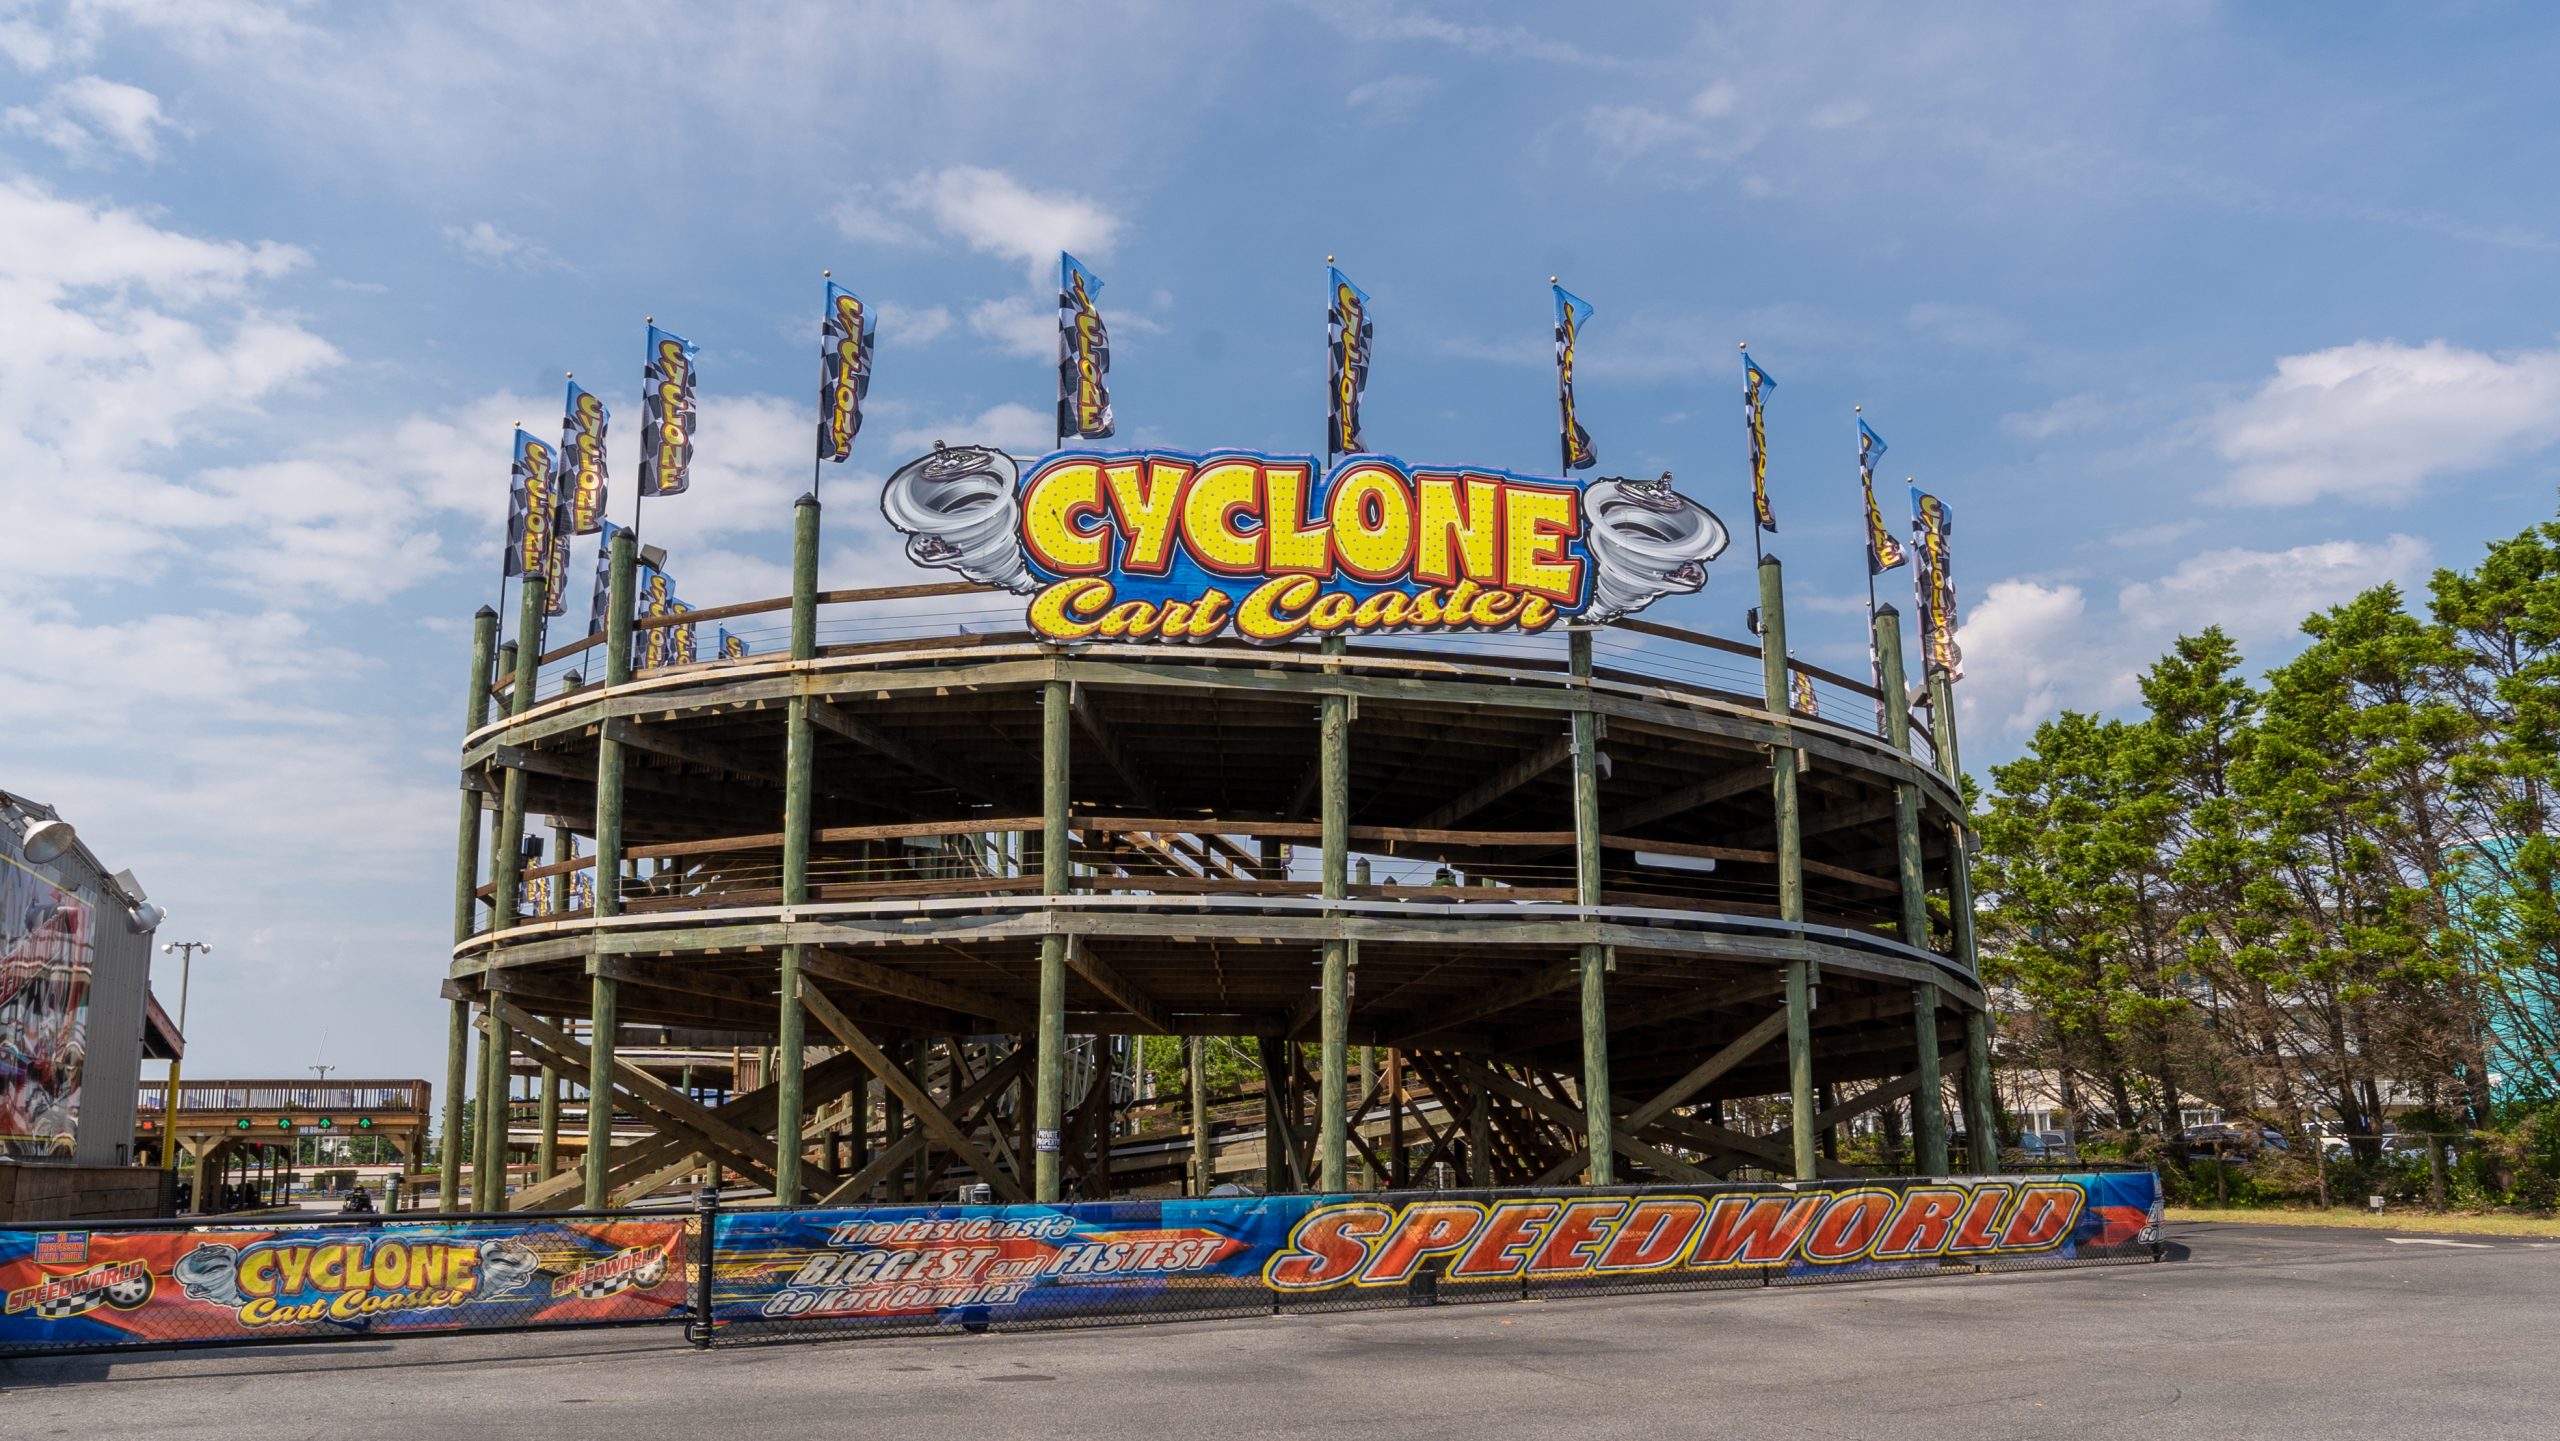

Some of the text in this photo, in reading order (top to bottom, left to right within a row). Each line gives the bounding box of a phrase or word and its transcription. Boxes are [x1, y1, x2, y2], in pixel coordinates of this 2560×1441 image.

[833, 295, 864, 456] CYCLONE
[657, 339, 689, 492] CYCLONE
[574, 392, 602, 532] CYCLONE
[523, 441, 549, 574] CYCLONE
[1022, 458, 1581, 594] CYCLONE
[1028, 574, 1558, 645] Cart Coaster
[831, 1217, 1074, 1244] The East Coast's
[1268, 1183, 2083, 1291] SPEEDWORLD
[8, 1260, 146, 1312] SPEEDWORLD
[238, 1241, 480, 1297] CYCLONE
[553, 1246, 663, 1296] SPEEDWORLD
[794, 1240, 1225, 1285] BIGGEST and FASTEST
[238, 1287, 466, 1326] Cart Coaster
[812, 1286, 892, 1312] Kart
[892, 1284, 1026, 1309] Complex
